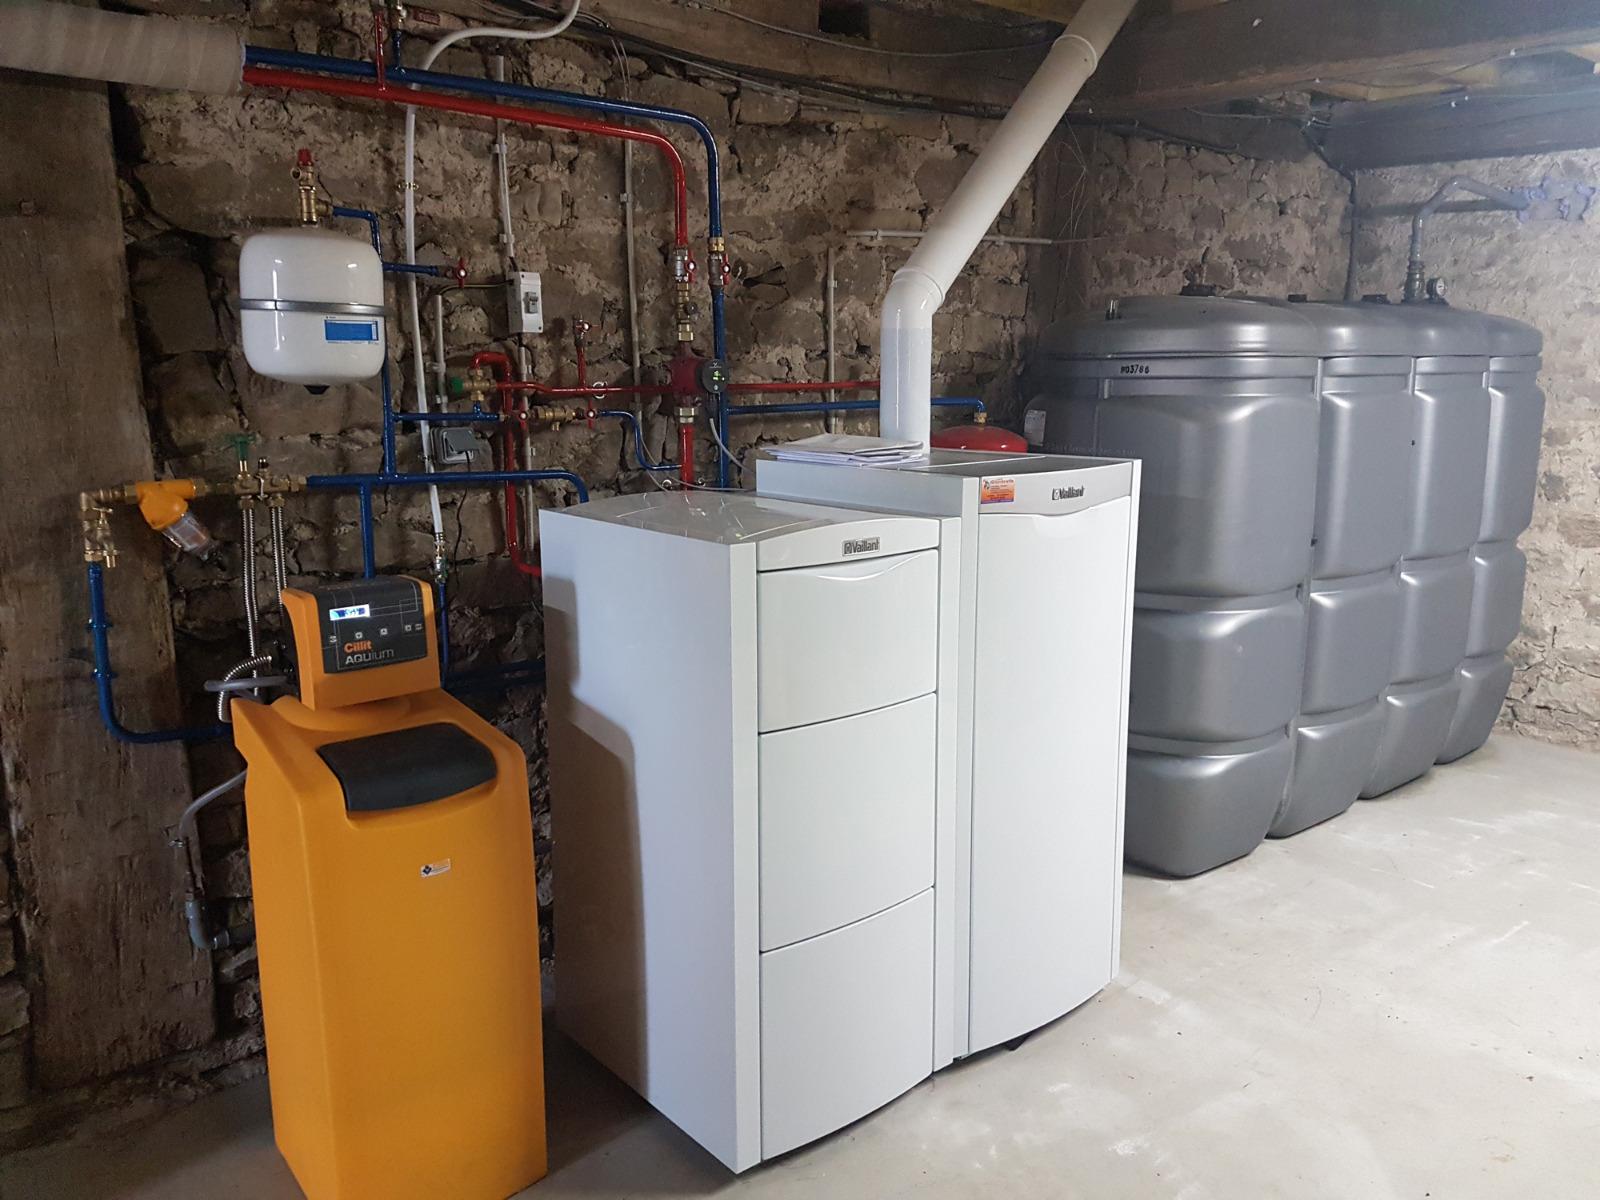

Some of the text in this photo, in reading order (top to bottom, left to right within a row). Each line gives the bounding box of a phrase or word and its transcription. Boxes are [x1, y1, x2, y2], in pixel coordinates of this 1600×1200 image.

[1060, 485, 1085, 499] Vaillant
[851, 538, 880, 553] Vaillant
[344, 640, 373, 653] Cillit
